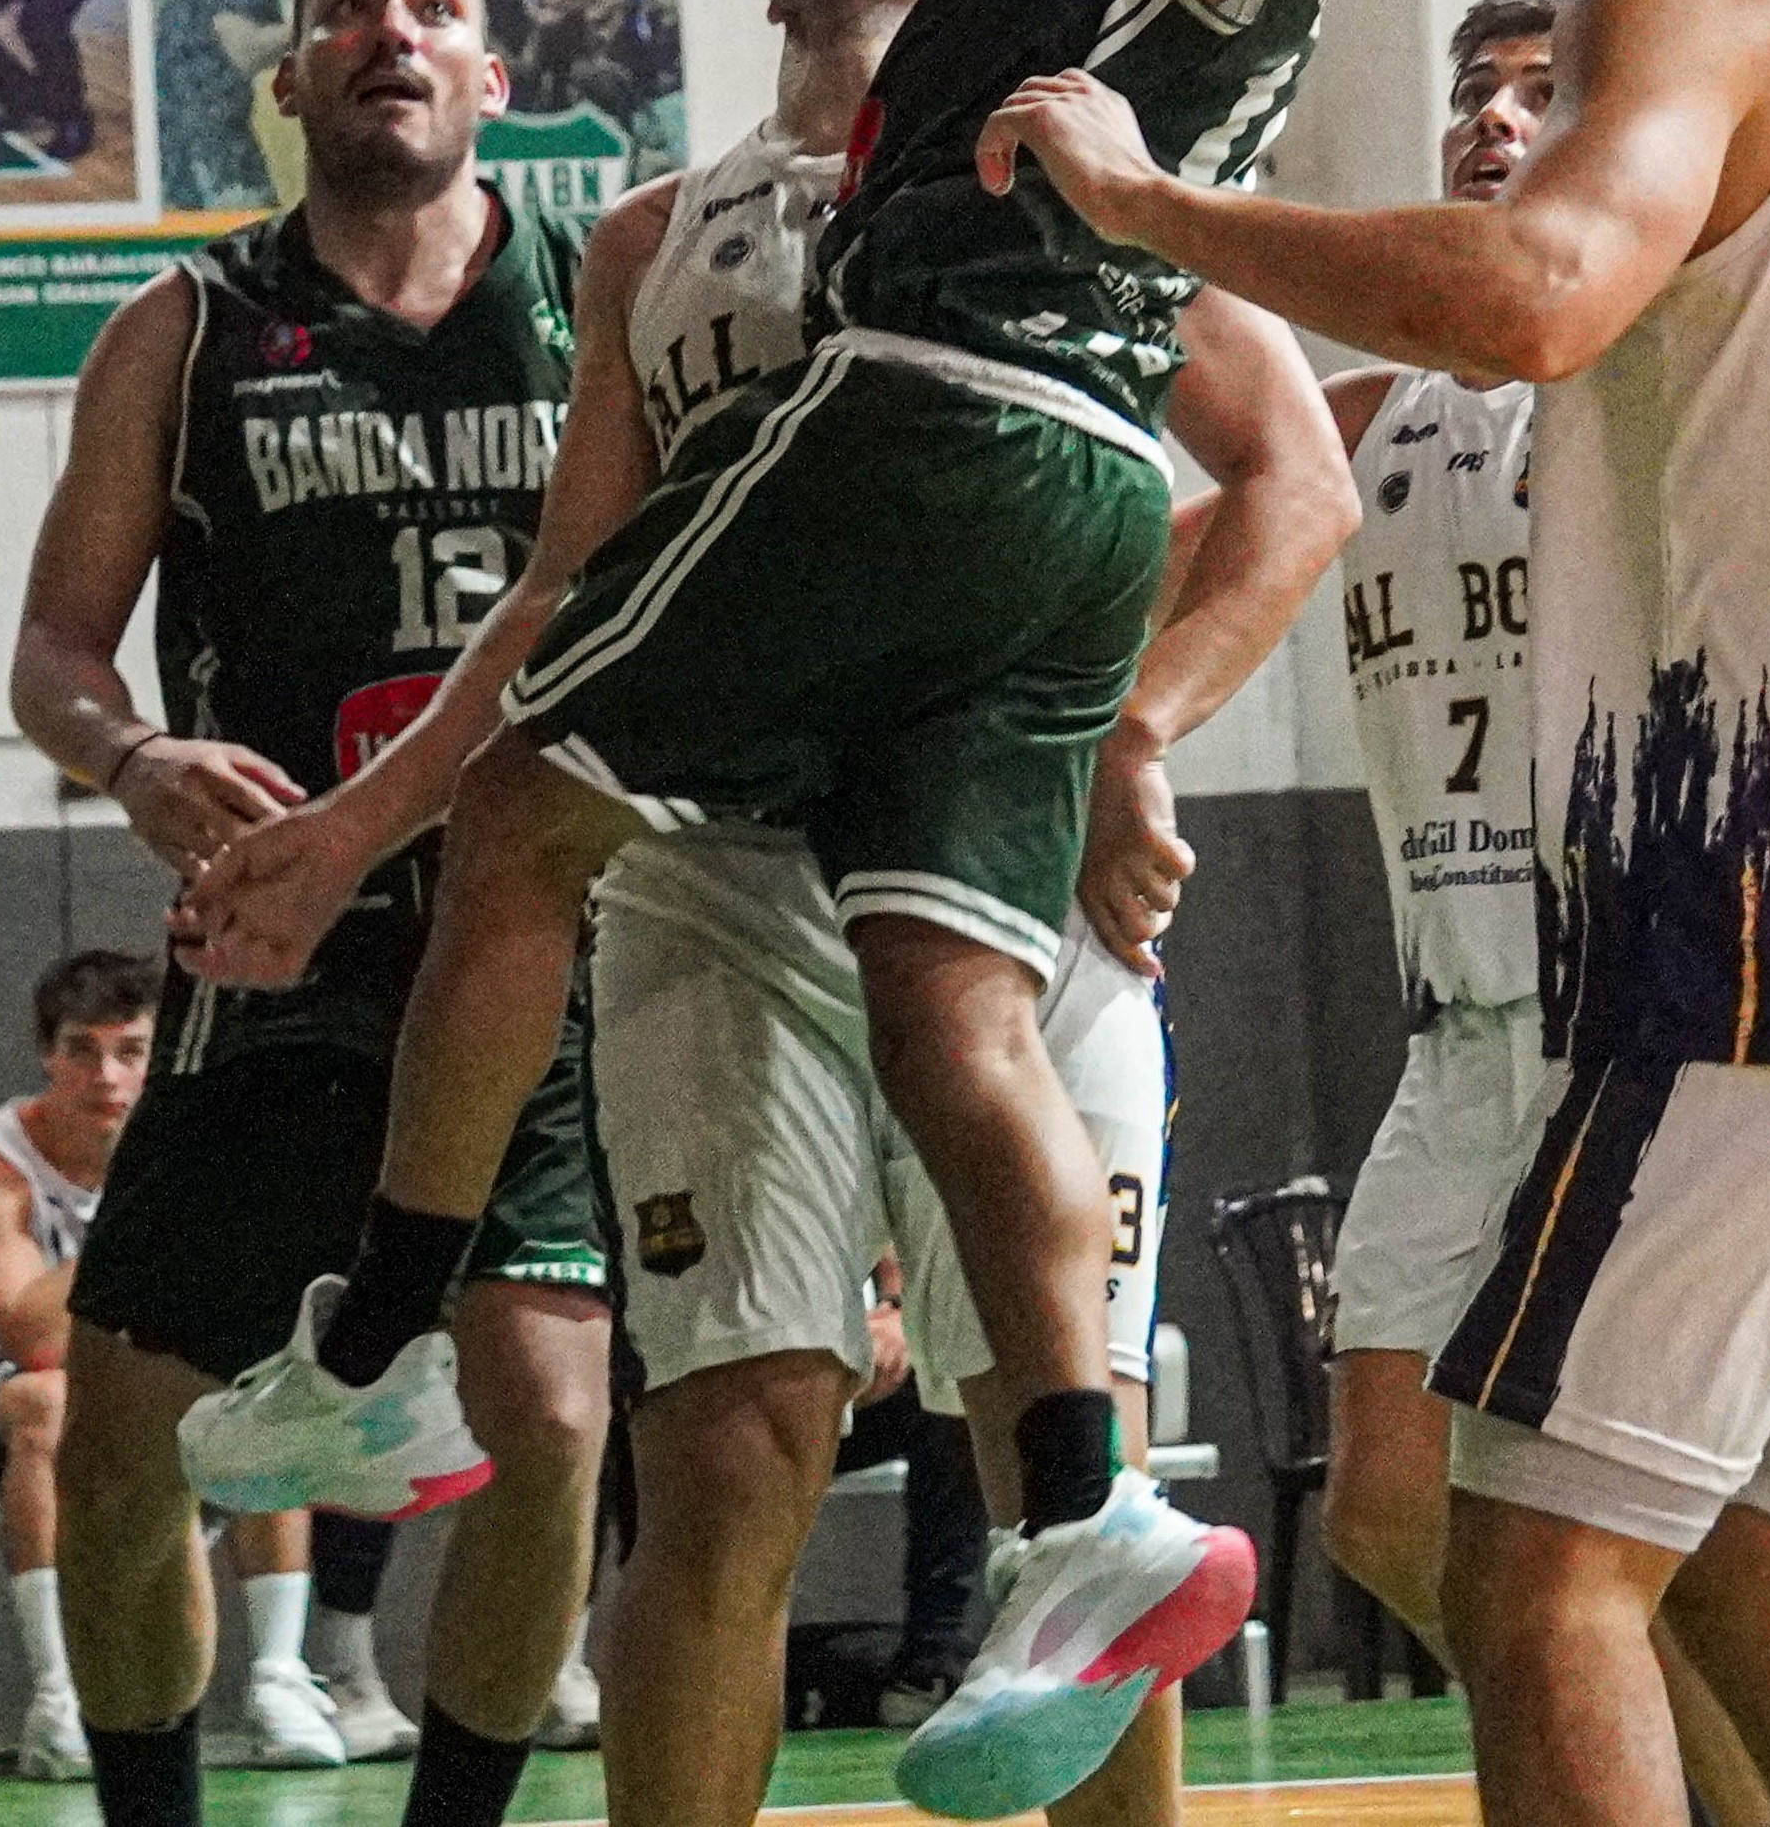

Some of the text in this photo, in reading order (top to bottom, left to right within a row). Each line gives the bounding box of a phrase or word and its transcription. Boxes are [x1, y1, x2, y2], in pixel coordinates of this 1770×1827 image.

[244, 399, 568, 515] BANDA NOR
[390, 524, 508, 654] 12
[1446, 697, 1490, 794] 7
